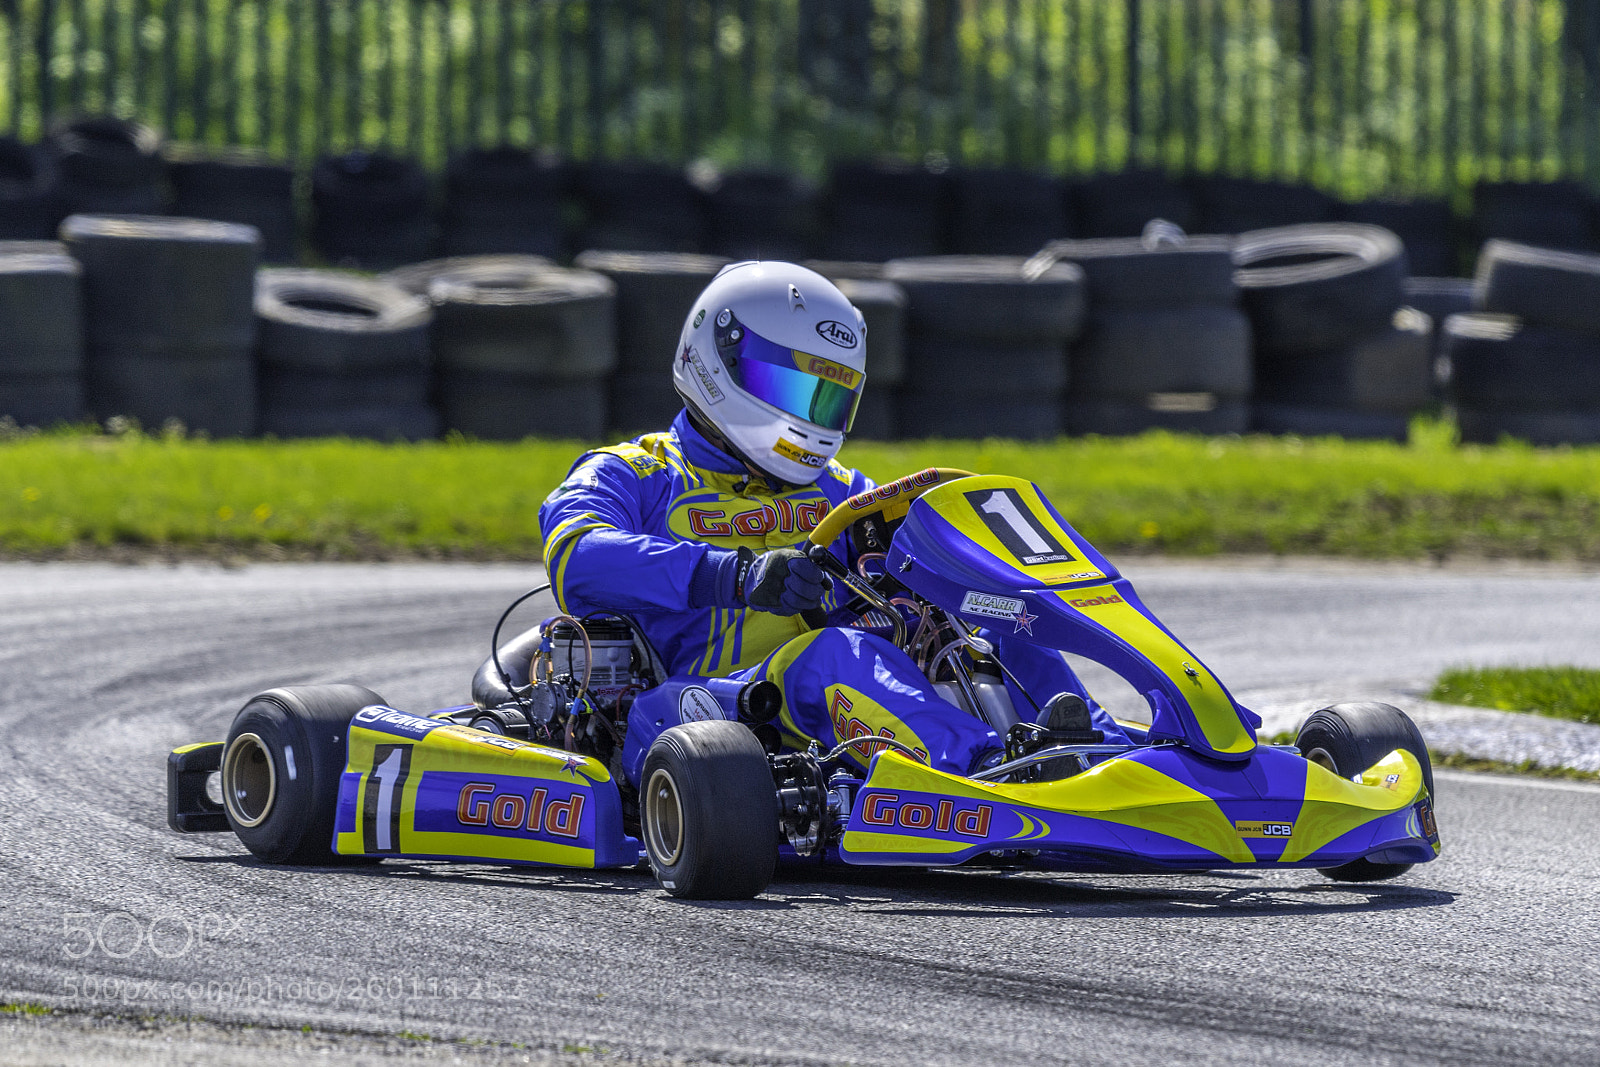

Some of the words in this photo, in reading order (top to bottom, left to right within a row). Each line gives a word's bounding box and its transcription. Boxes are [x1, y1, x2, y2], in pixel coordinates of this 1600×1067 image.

[820, 322, 854, 344] Arai
[808, 357, 854, 385] Gold
[801, 455, 826, 467] JCB
[688, 498, 829, 536] Gold
[980, 490, 1054, 554] 1
[967, 593, 1016, 612] N.CARR
[981, 608, 1012, 618] RACING
[1069, 594, 1124, 608] Gold
[374, 748, 403, 850] 1
[457, 780, 586, 839] Gold
[861, 793, 993, 838] Gold
[1263, 824, 1292, 836] JCB
